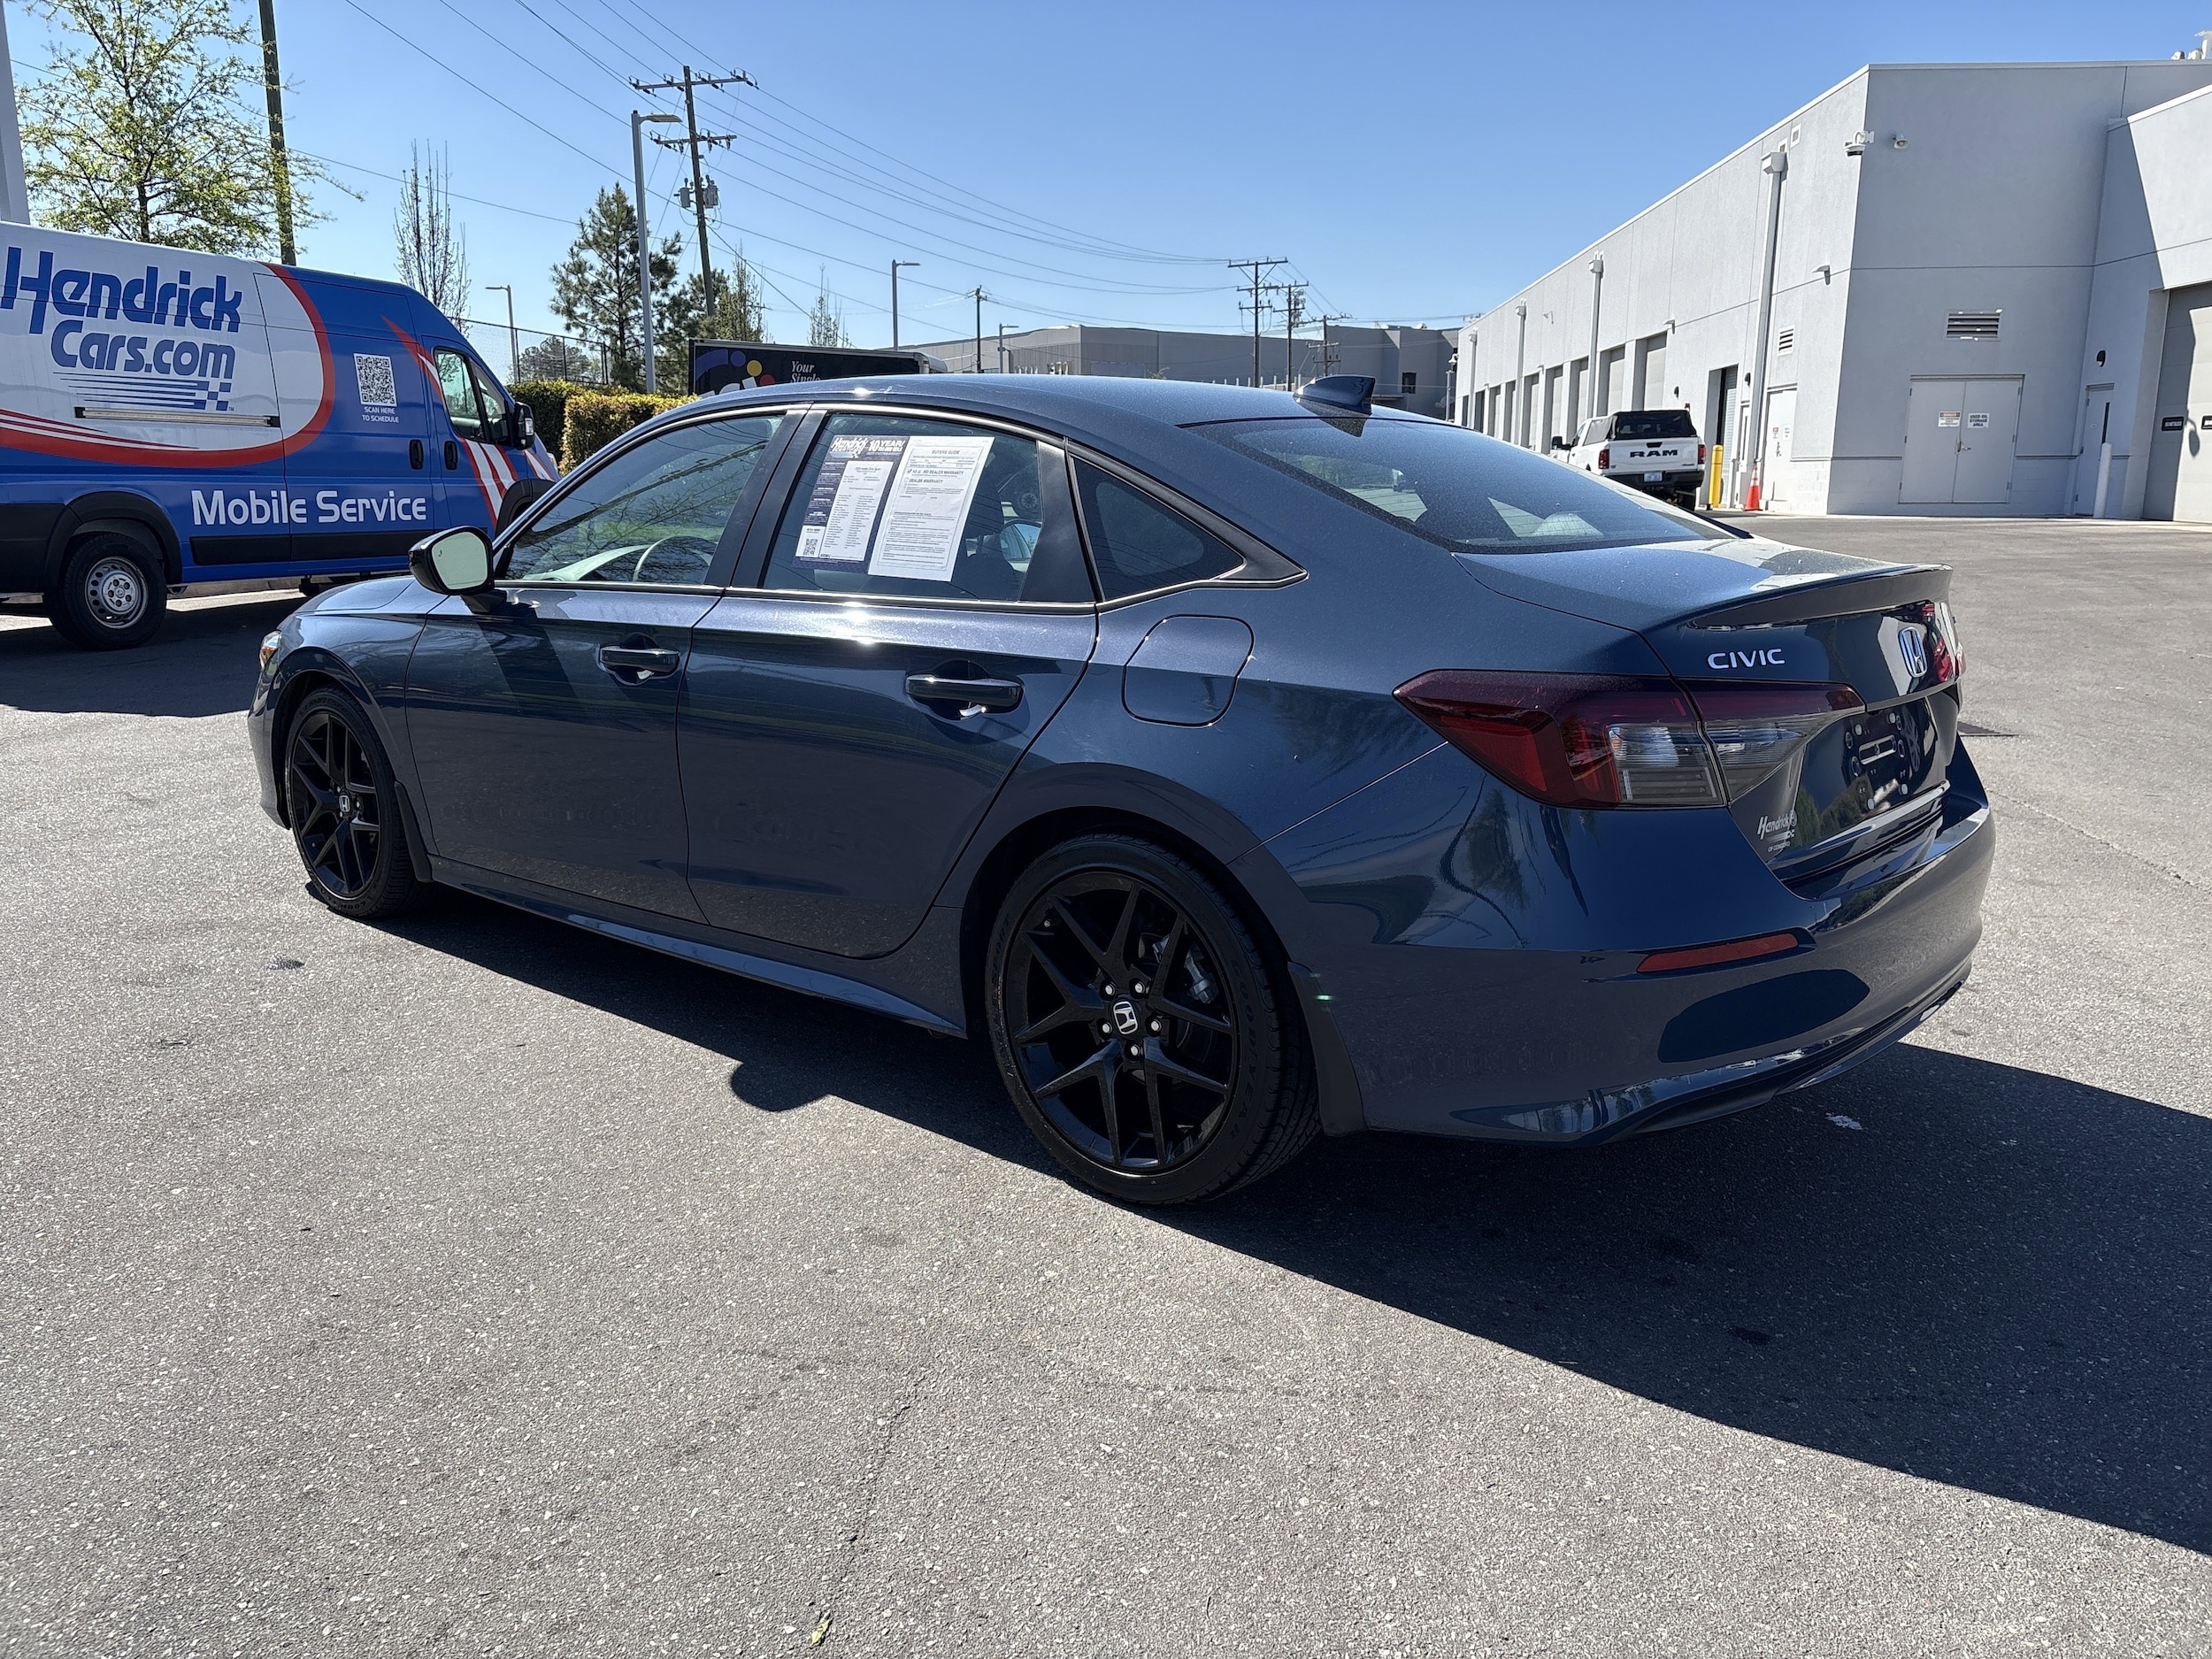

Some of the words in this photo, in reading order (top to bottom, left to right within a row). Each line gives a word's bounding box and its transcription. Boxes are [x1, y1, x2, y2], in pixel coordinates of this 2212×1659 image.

[1, 246, 242, 334] Hendrick
[50, 319, 236, 380] Cars.com
[791, 360, 815, 373] Your
[868, 440, 880, 452] 10
[1630, 449, 1678, 458] RAM
[191, 489, 308, 526] Mobile
[316, 490, 426, 523] Service
[1708, 649, 1786, 669] CIVIC
